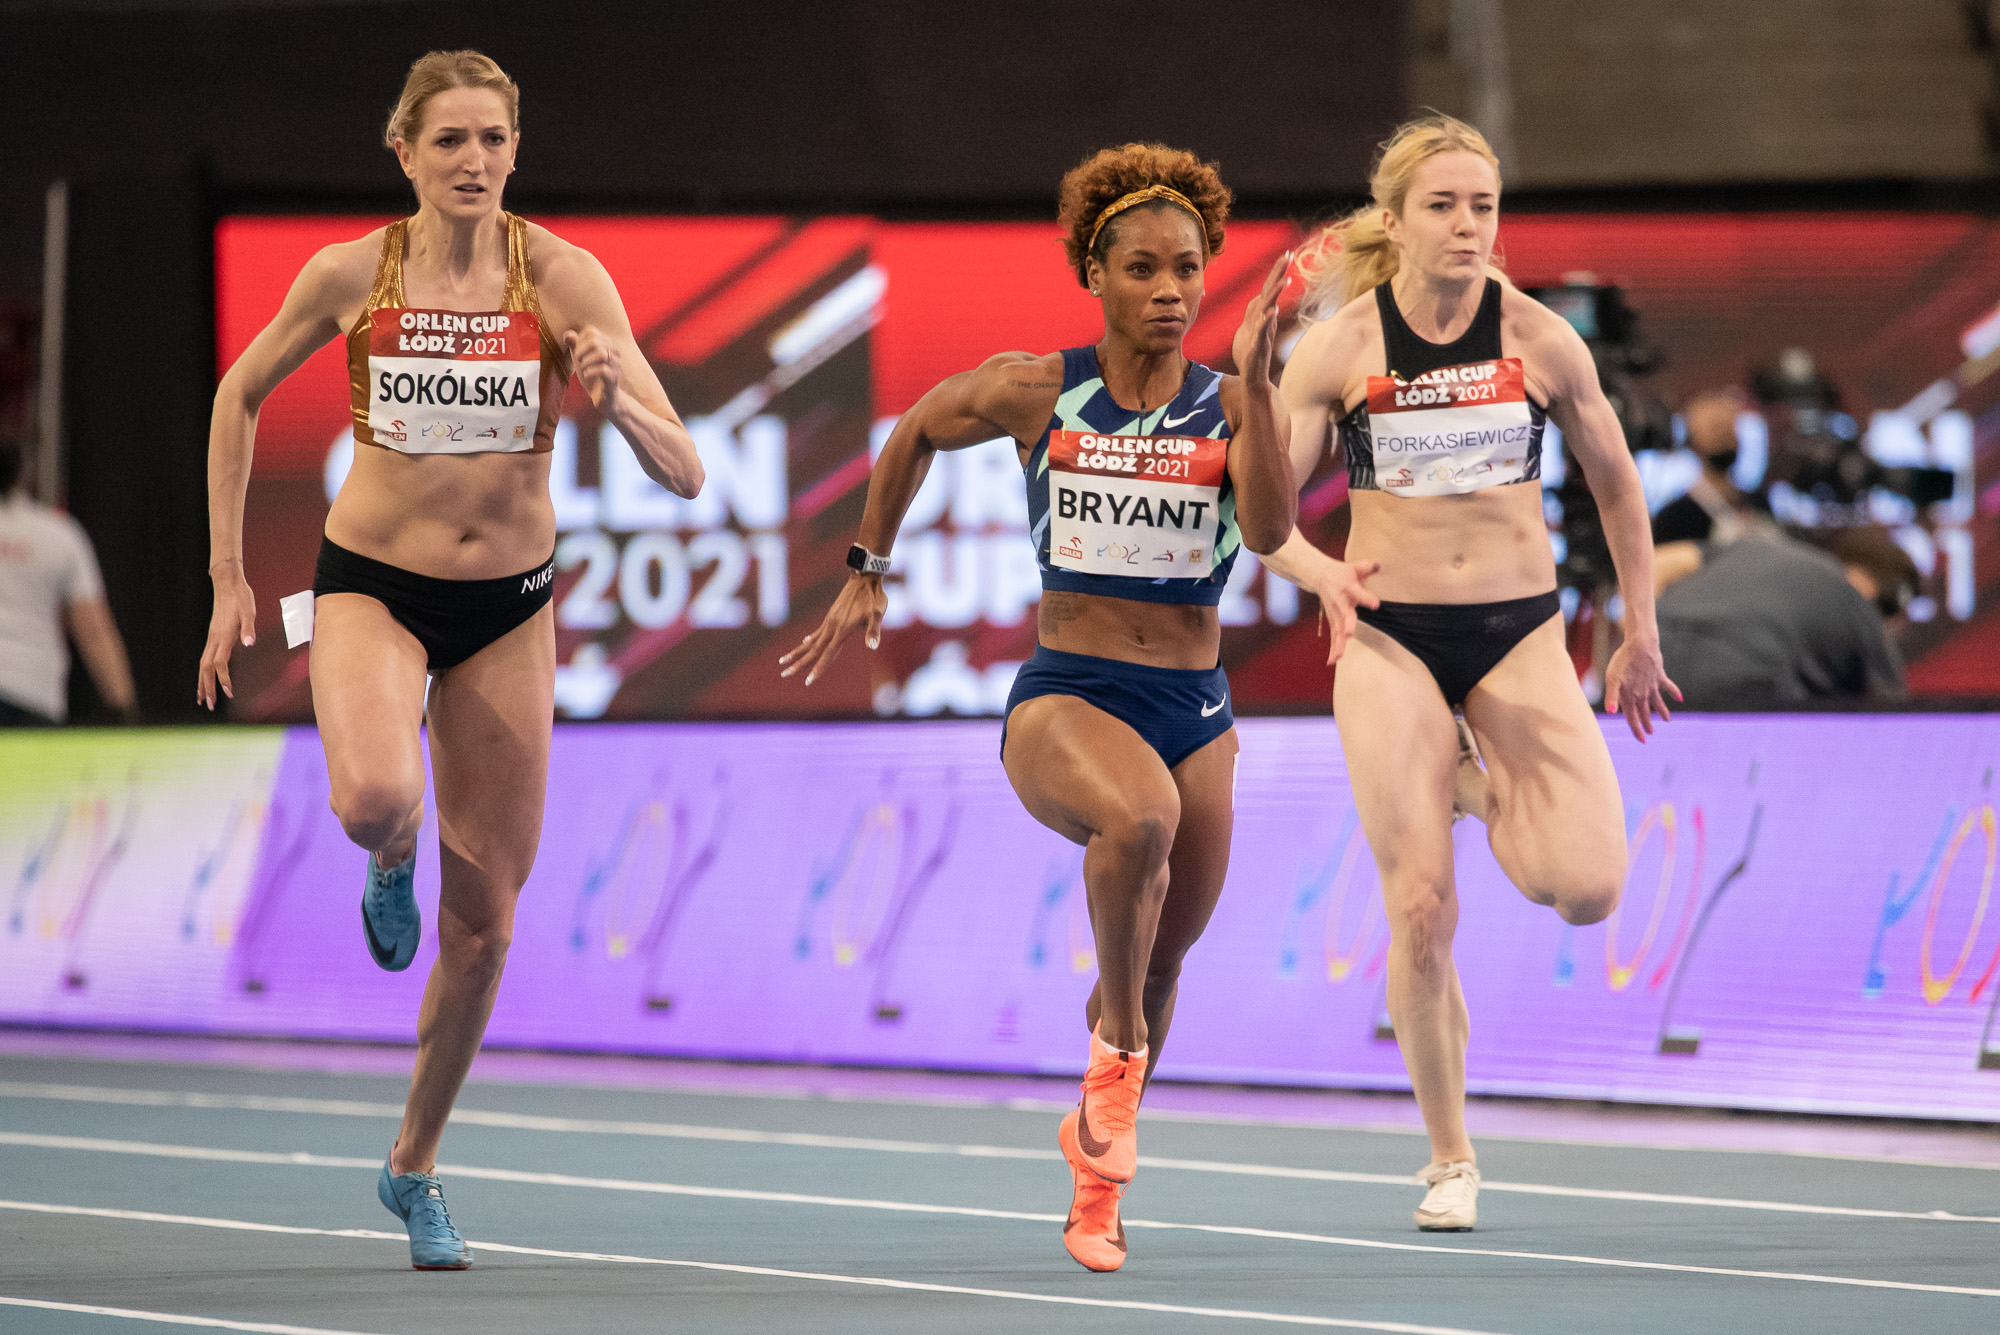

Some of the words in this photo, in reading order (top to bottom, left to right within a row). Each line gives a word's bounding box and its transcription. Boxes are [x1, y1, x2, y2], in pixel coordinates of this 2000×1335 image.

[400, 312, 467, 333] ORLEN
[469, 315, 511, 332] CUP
[398, 333, 456, 353] ŁÓDŹ
[462, 338, 506, 354] 2021
[1459, 364, 1498, 382] CUP
[378, 369, 530, 407] SOKÓLSKA
[1395, 383, 1451, 406] ŁÓDŹ
[1455, 383, 1497, 402] 2021
[1079, 435, 1152, 454] ORLEN
[1154, 439, 1197, 456] CUP
[1377, 426, 1527, 452] FORKASIEWICZ
[1077, 451, 1138, 472] ŁÓDŹ
[1144, 458, 1190, 477] 2021
[1058, 487, 1210, 530] BRYANT
[521, 562, 553, 594] NIKE
[552, 529, 790, 630] 2021
